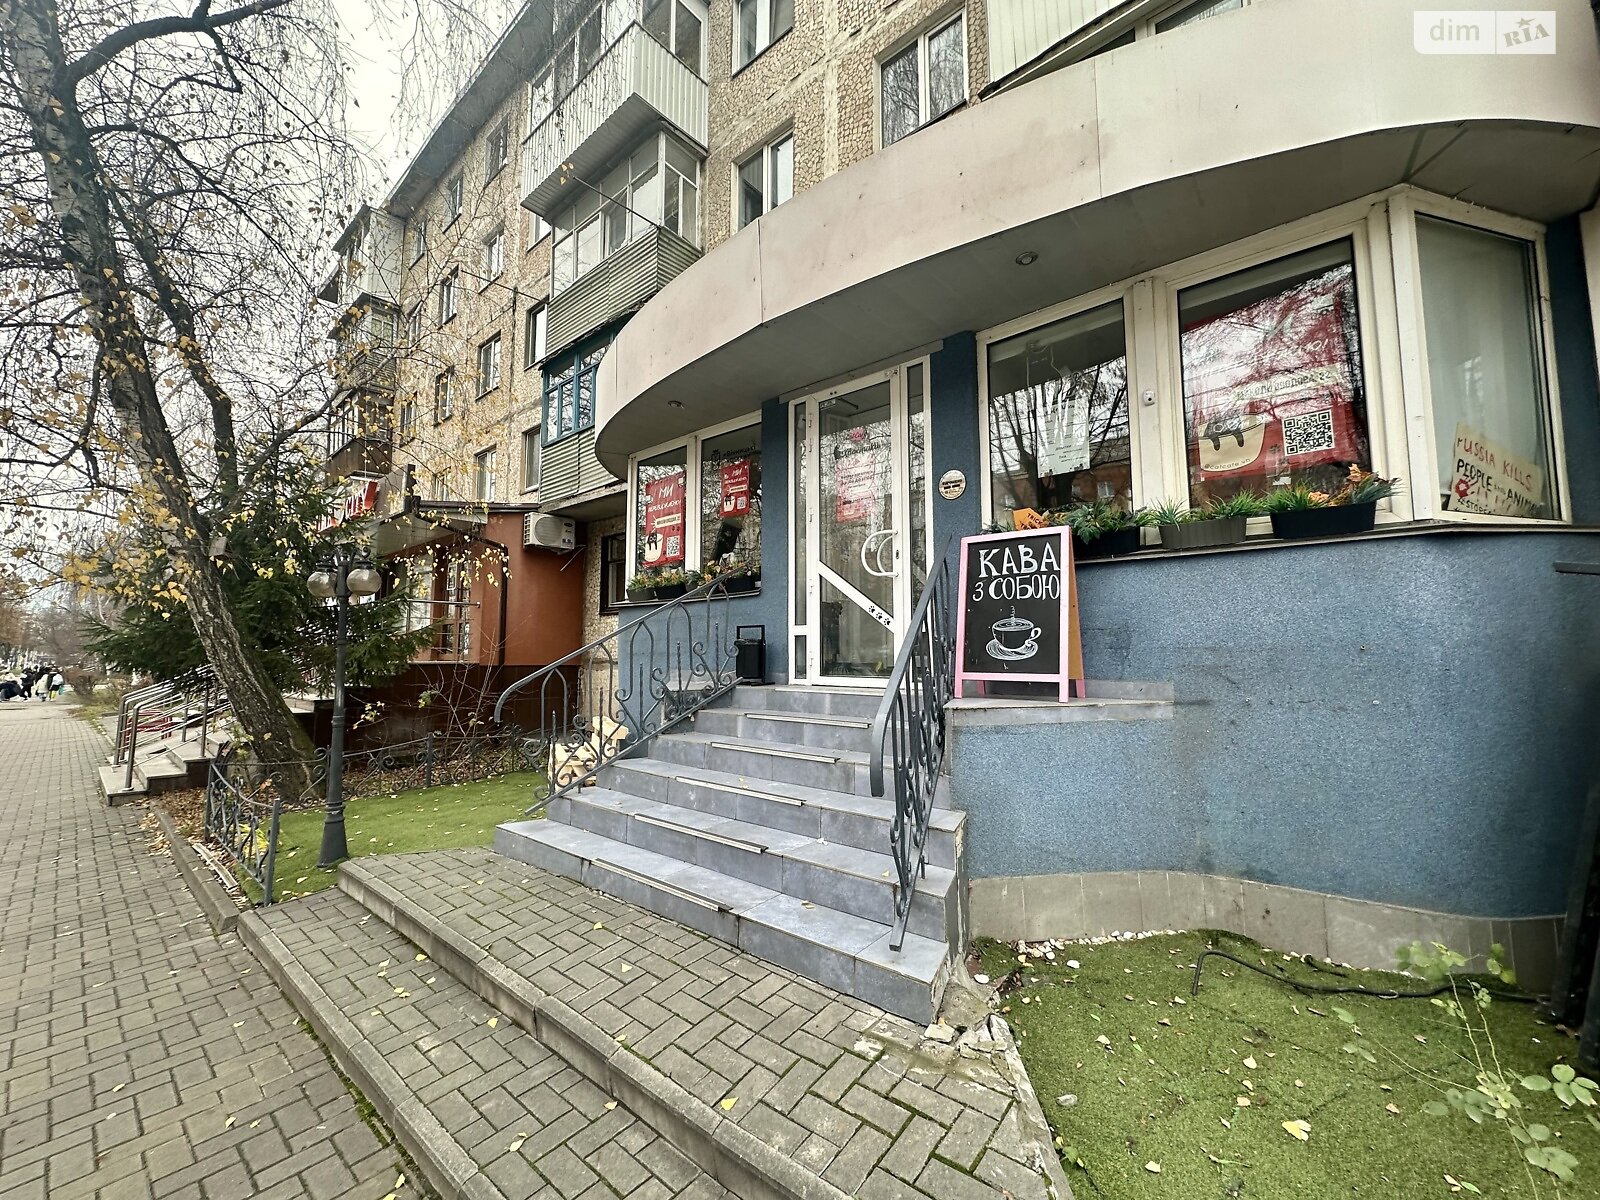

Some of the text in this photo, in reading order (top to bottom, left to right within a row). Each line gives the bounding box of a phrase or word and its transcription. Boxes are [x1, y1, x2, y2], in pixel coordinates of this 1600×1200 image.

[1456, 458, 1493, 492] PEOPLE
[1502, 460, 1534, 492] KILLS
[658, 484, 674, 499] МИ
[978, 542, 1061, 578] КАВА
[988, 574, 1060, 601] СОБОЮ
